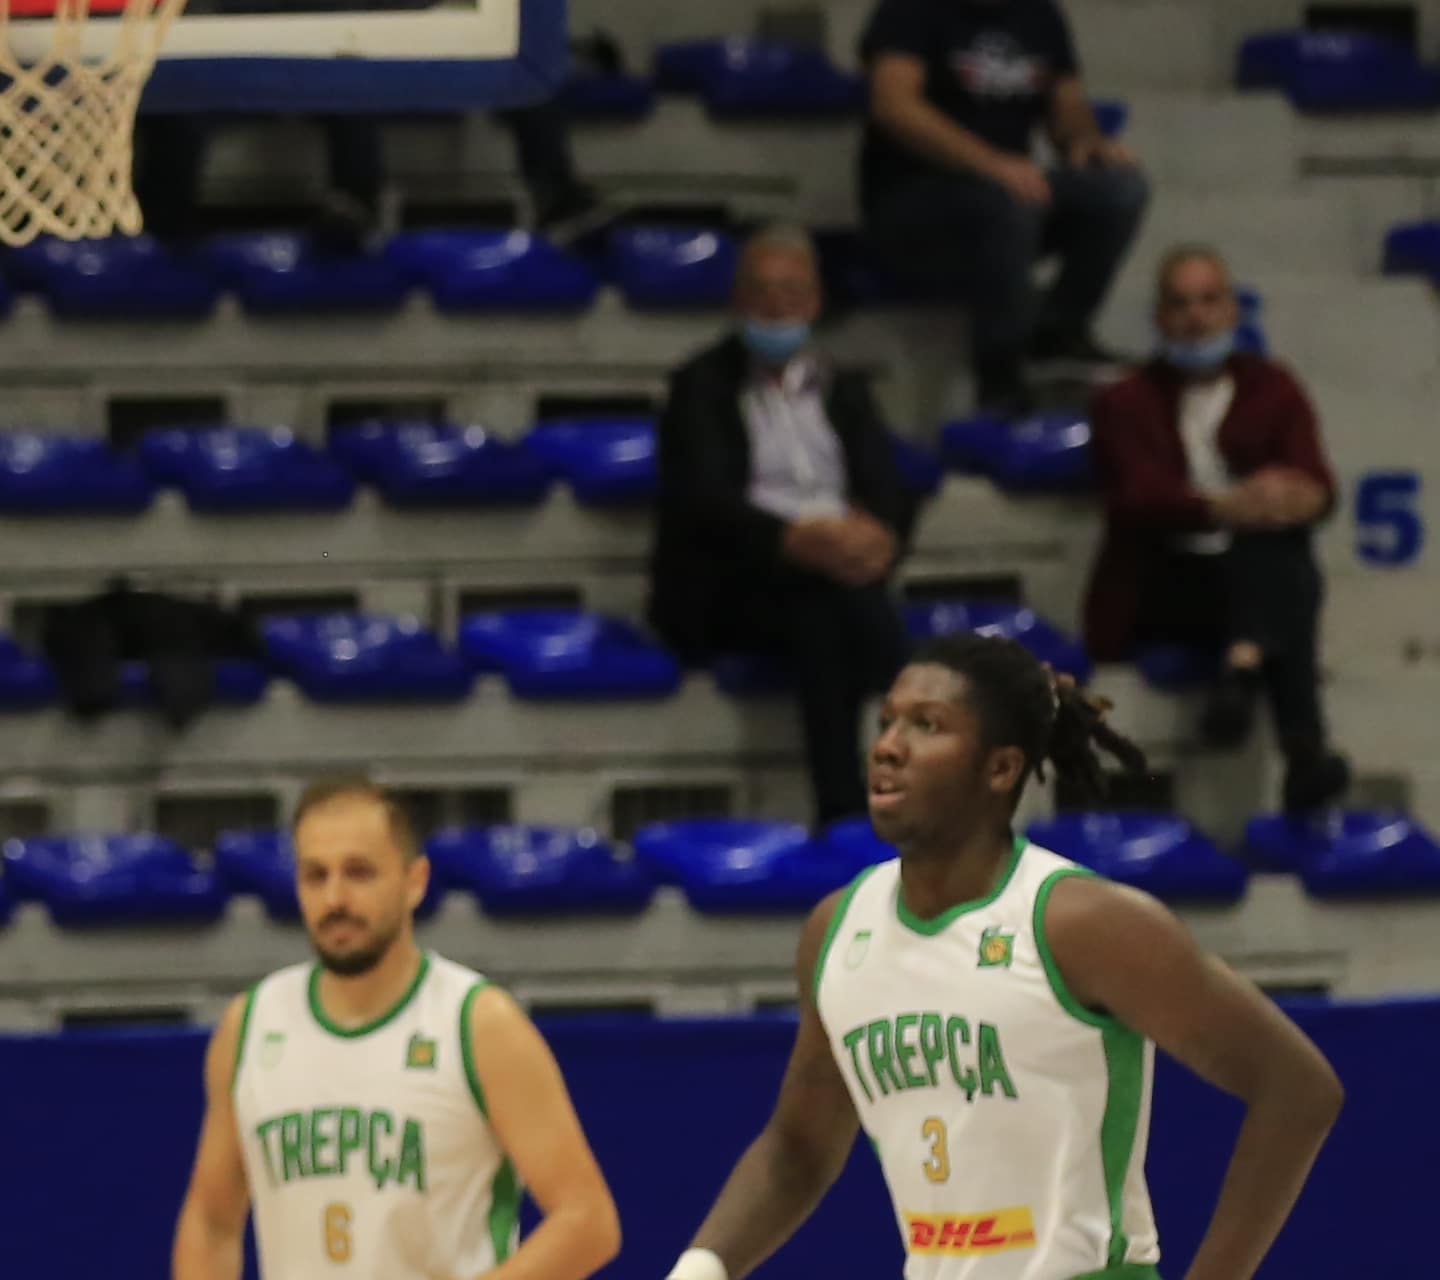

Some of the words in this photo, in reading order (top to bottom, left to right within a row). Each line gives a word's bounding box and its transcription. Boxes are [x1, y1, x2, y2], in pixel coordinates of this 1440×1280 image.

[1354, 469, 1425, 567] 5
[842, 1011, 1019, 1103] TREPÇA
[256, 1106, 427, 1192] TREPÇA
[921, 1116, 951, 1184] 3
[324, 1202, 353, 1263] 6
[910, 1217, 1007, 1248] DHL
